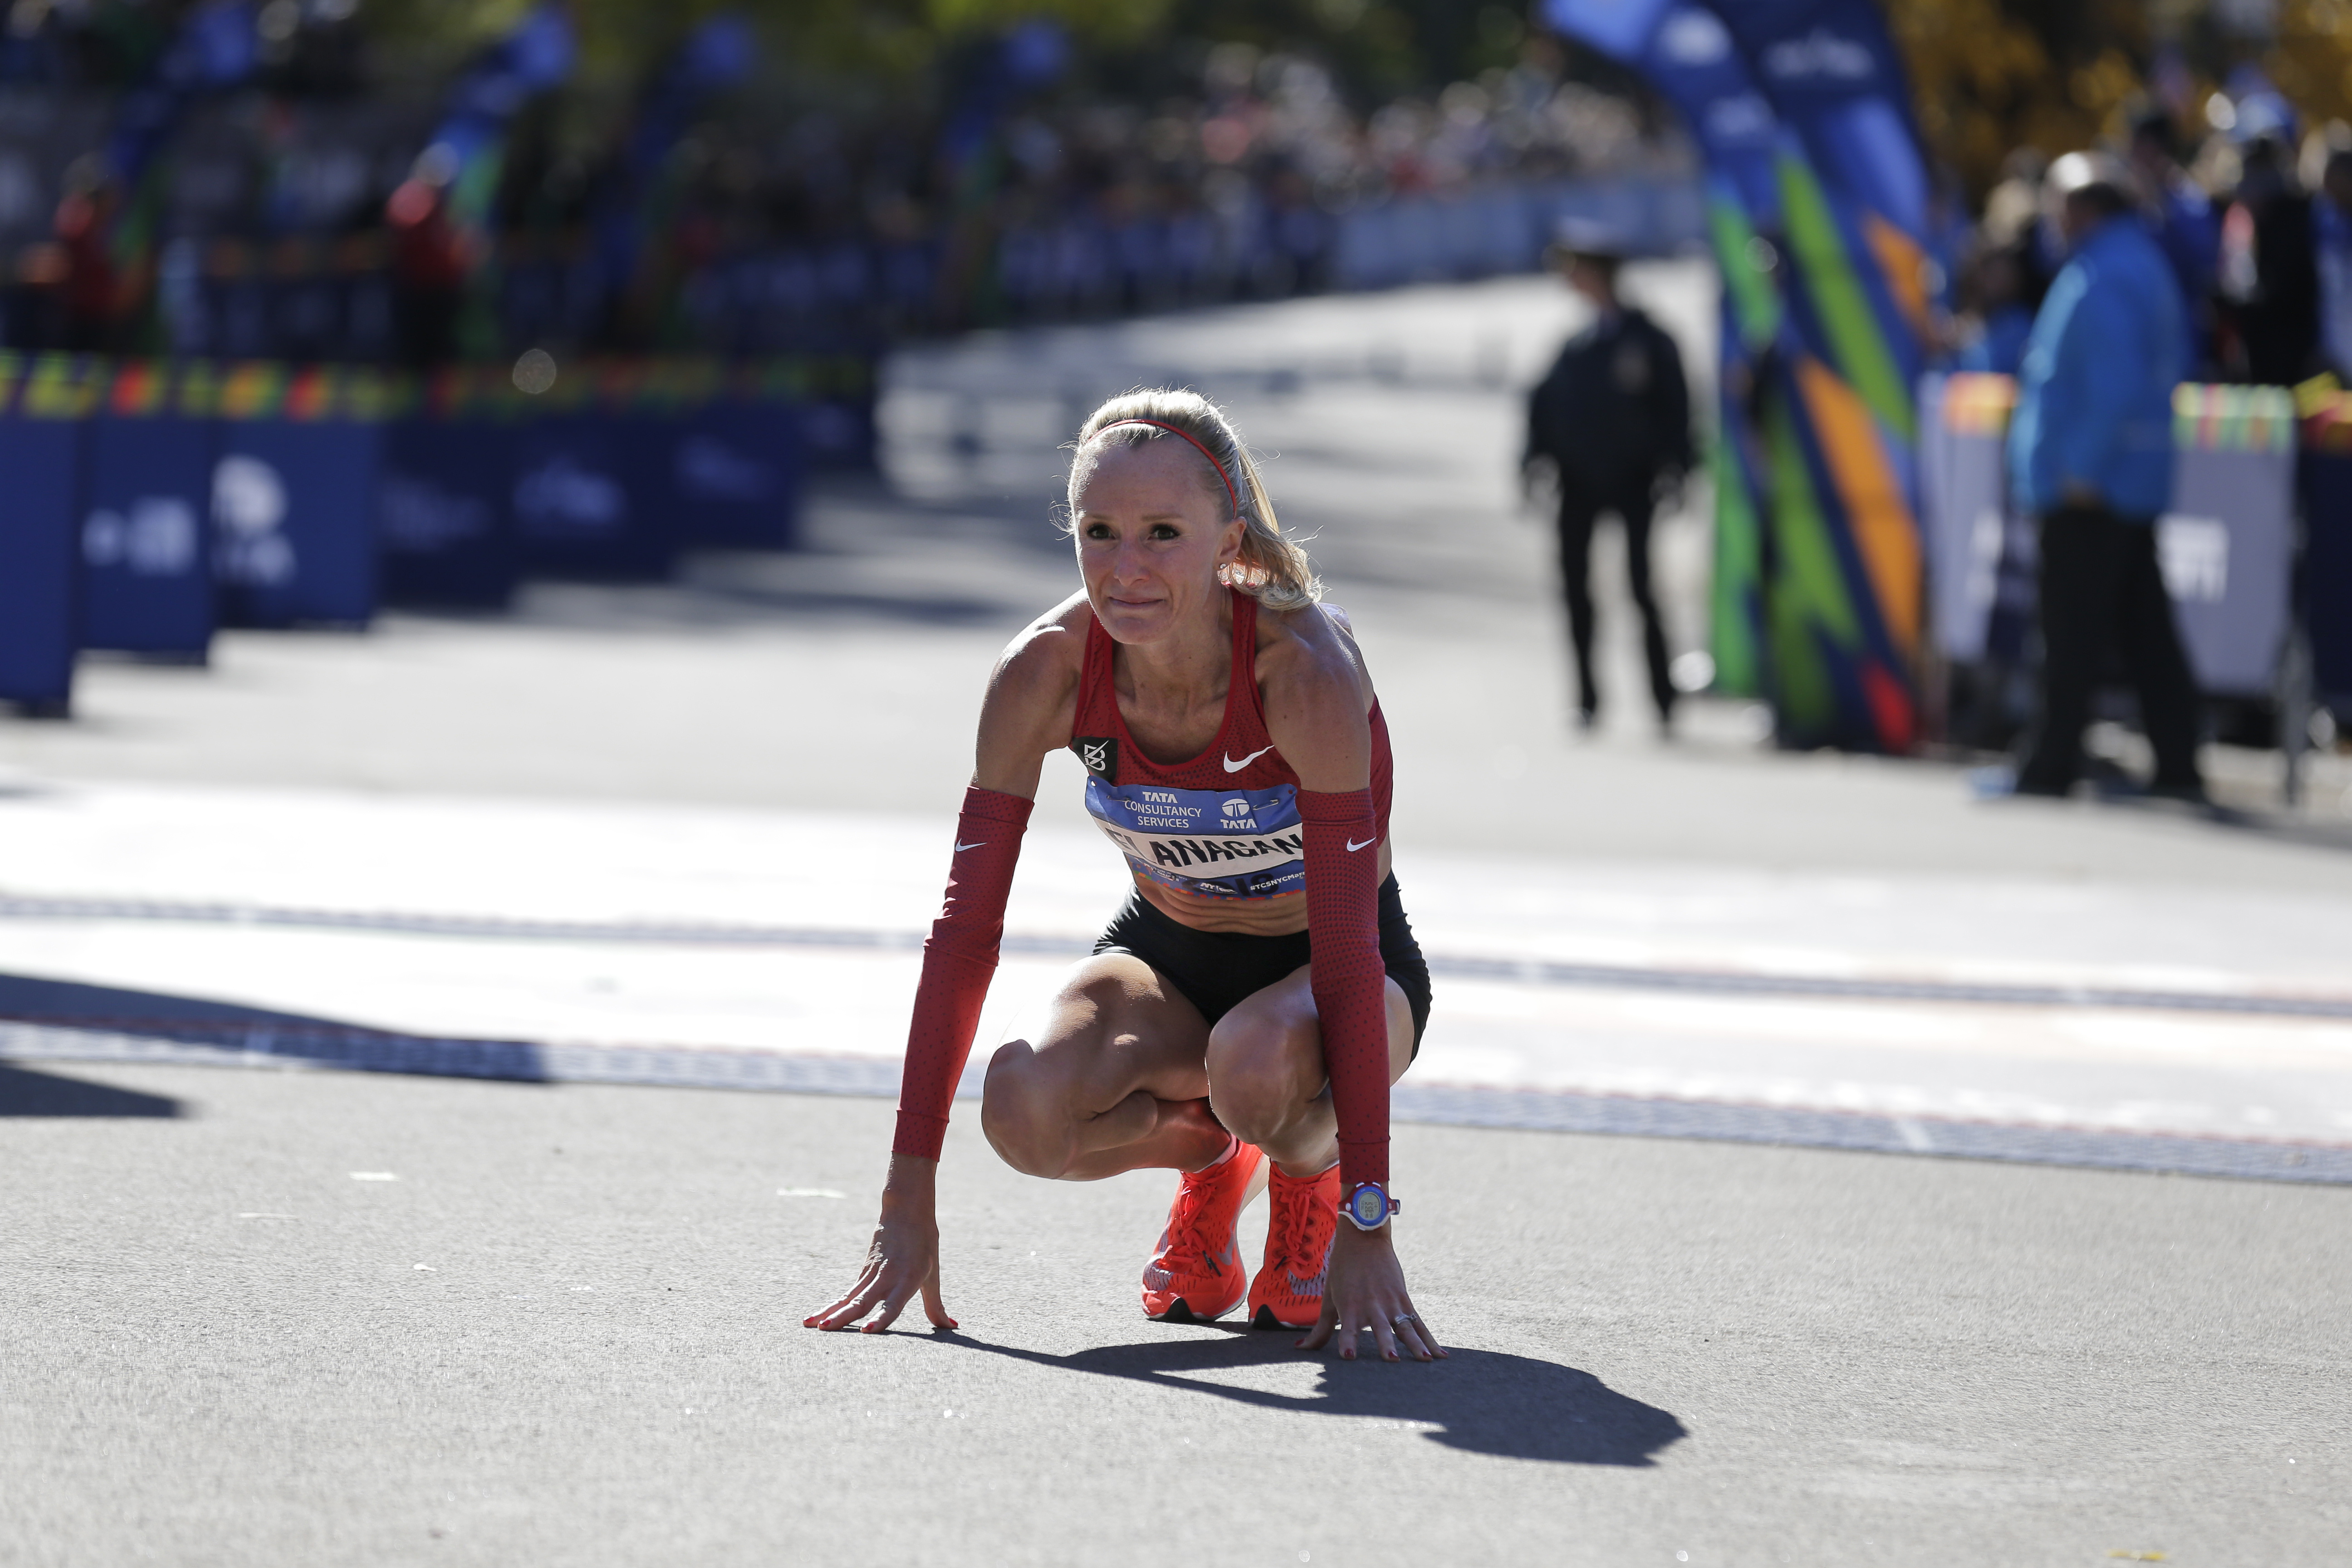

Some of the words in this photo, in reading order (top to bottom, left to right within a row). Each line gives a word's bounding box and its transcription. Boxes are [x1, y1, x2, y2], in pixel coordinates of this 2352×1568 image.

[1142, 791, 1178, 804] TATA
[1124, 800, 1202, 818] CONSULTANCY
[1137, 816, 1190, 828] SERVICES
[1220, 818, 1257, 829] TATA
